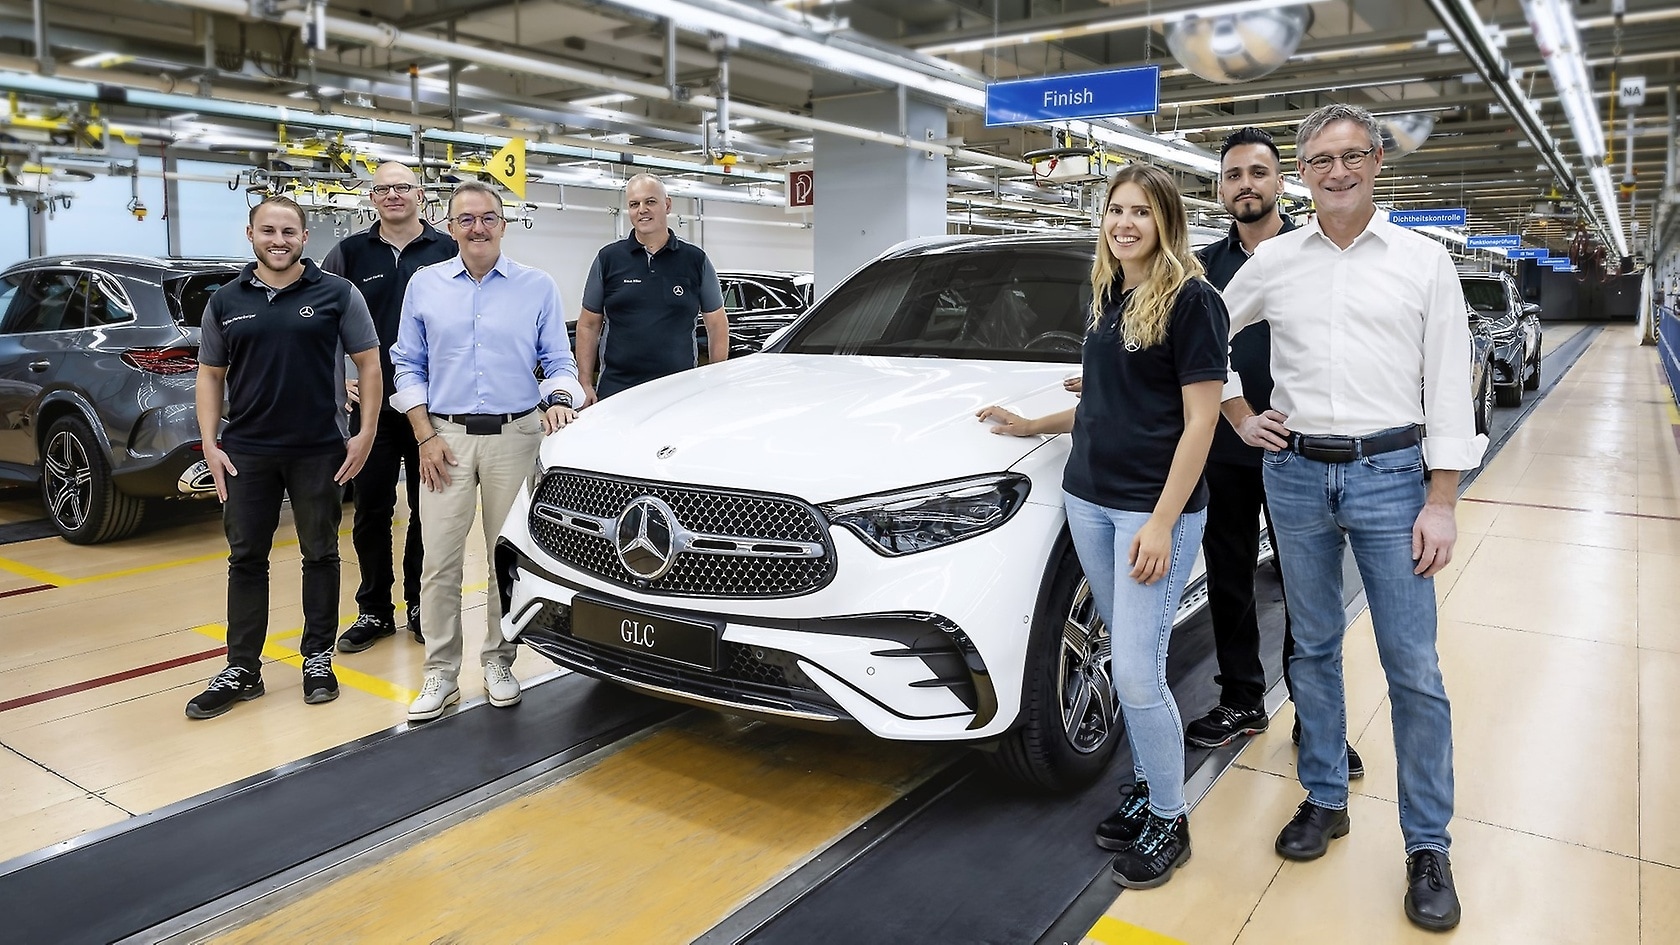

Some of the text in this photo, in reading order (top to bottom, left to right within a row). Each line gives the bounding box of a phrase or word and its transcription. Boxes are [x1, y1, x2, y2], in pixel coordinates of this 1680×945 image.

[1623, 86, 1641, 96] NA
[1043, 87, 1093, 107] Finish
[505, 153, 516, 177] 3
[1392, 213, 1461, 223] Dichtheitskontrolle
[343, 228, 350, 238] 2
[1469, 238, 1517, 246] Funktionsprüfung
[620, 619, 655, 648] GLC
